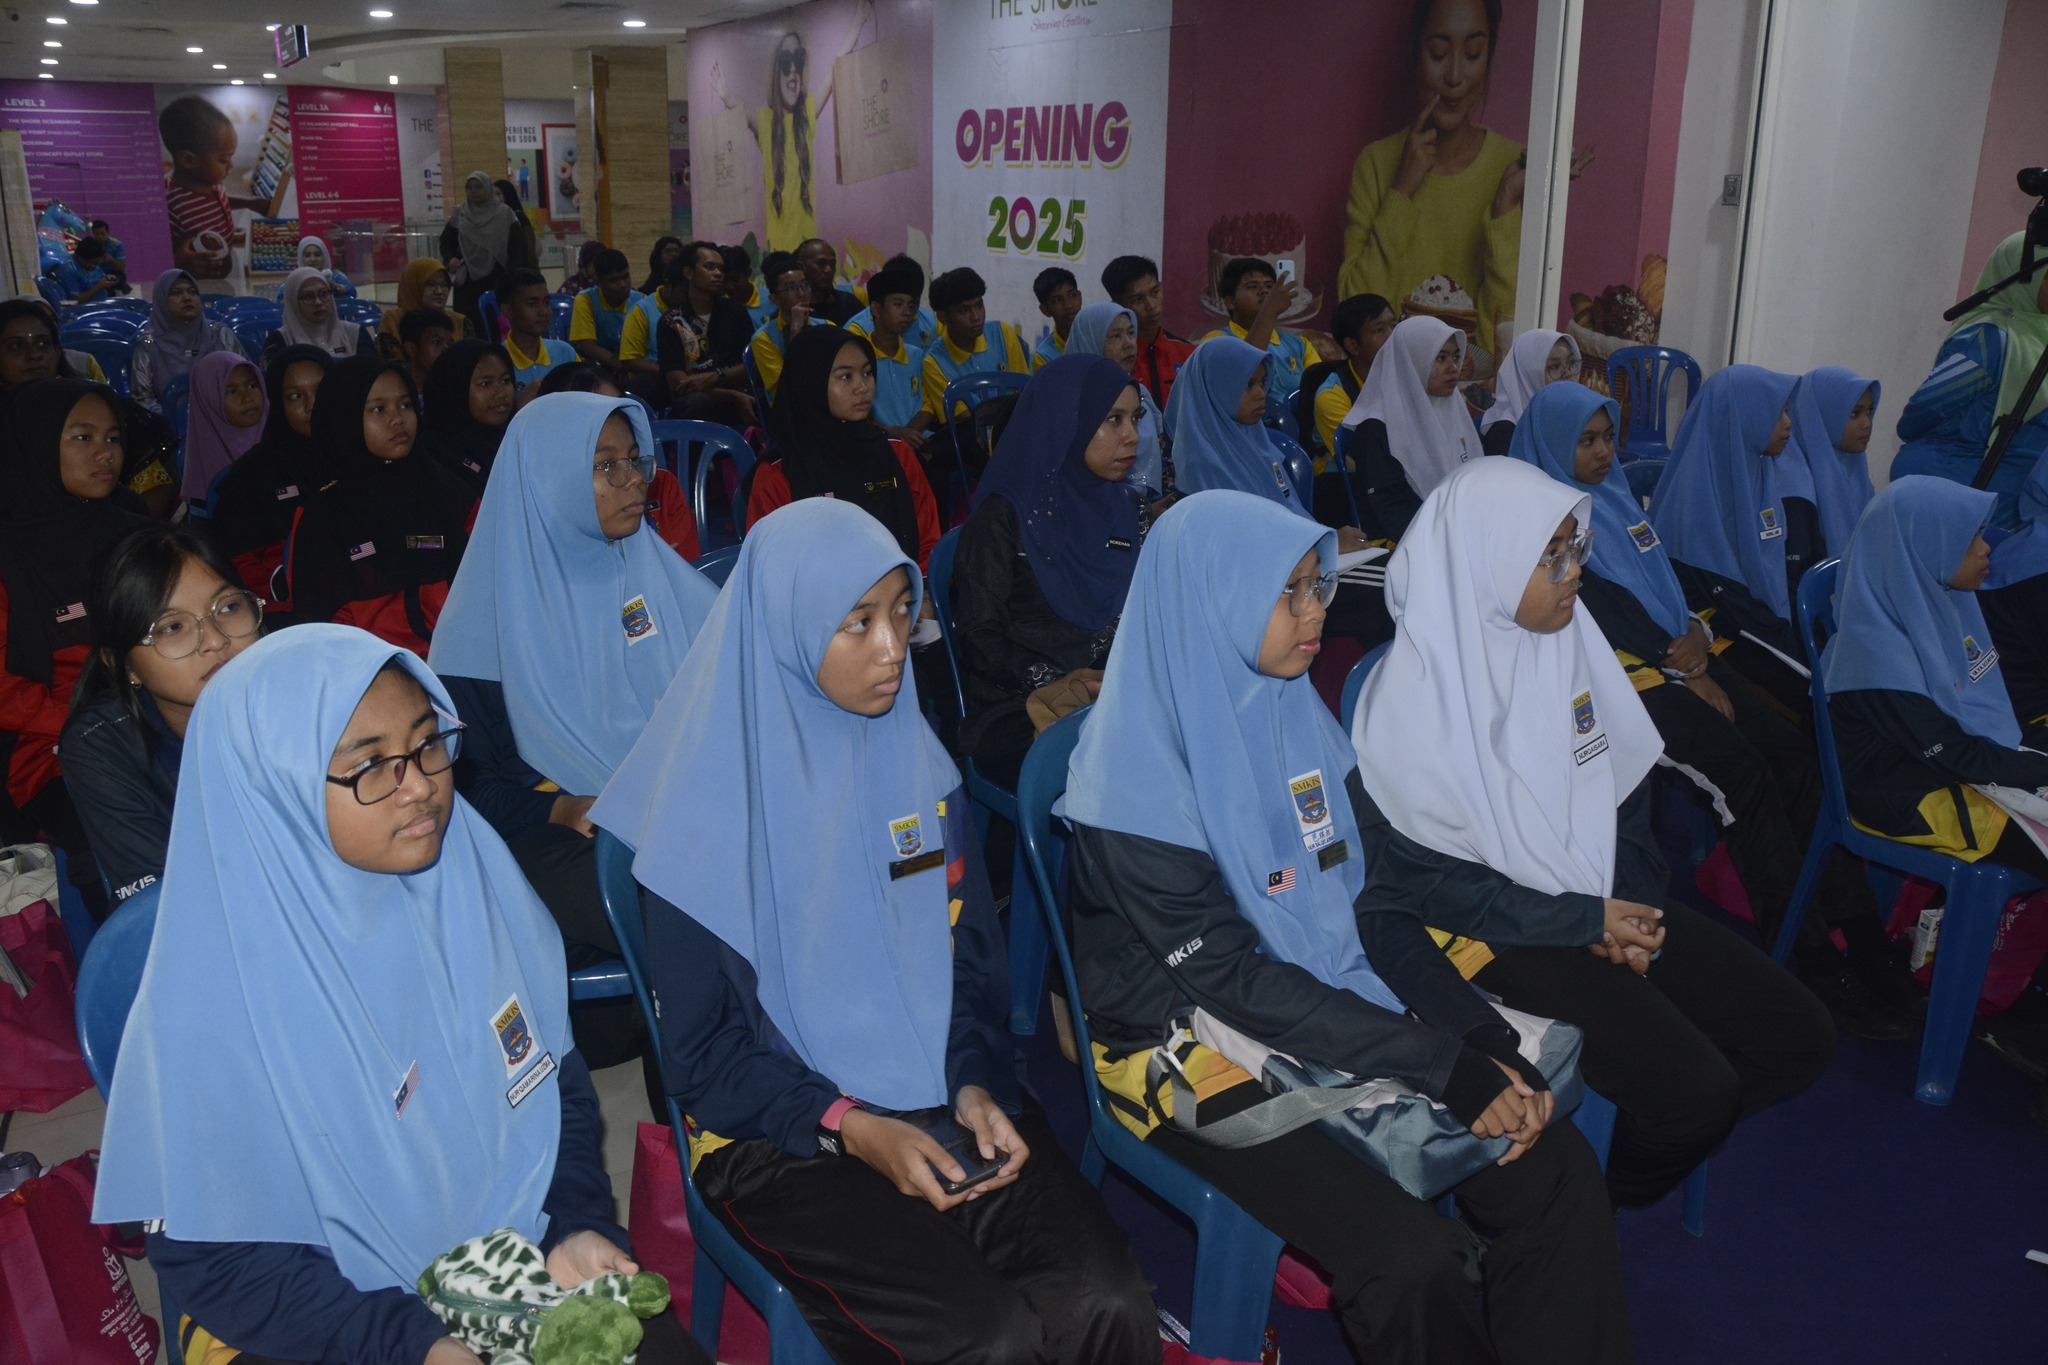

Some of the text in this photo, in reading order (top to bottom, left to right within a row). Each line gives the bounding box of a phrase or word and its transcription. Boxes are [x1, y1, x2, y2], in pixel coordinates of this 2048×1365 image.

[5, 98, 46, 107] LEVEL 2
[862, 96, 877, 112] THE
[411, 118, 434, 132] THE
[863, 108, 890, 131] SHORE
[956, 101, 1131, 169] OPENING
[987, 196, 1088, 262] 2025
[1578, 739, 1606, 760] NURQAISARA
[1923, 743, 1944, 758] KIS
[1293, 777, 1321, 792] SMKIS
[894, 819, 919, 832] SMKIS
[496, 1003, 520, 1032] SMKIS
[509, 1089, 520, 1102] NUR
